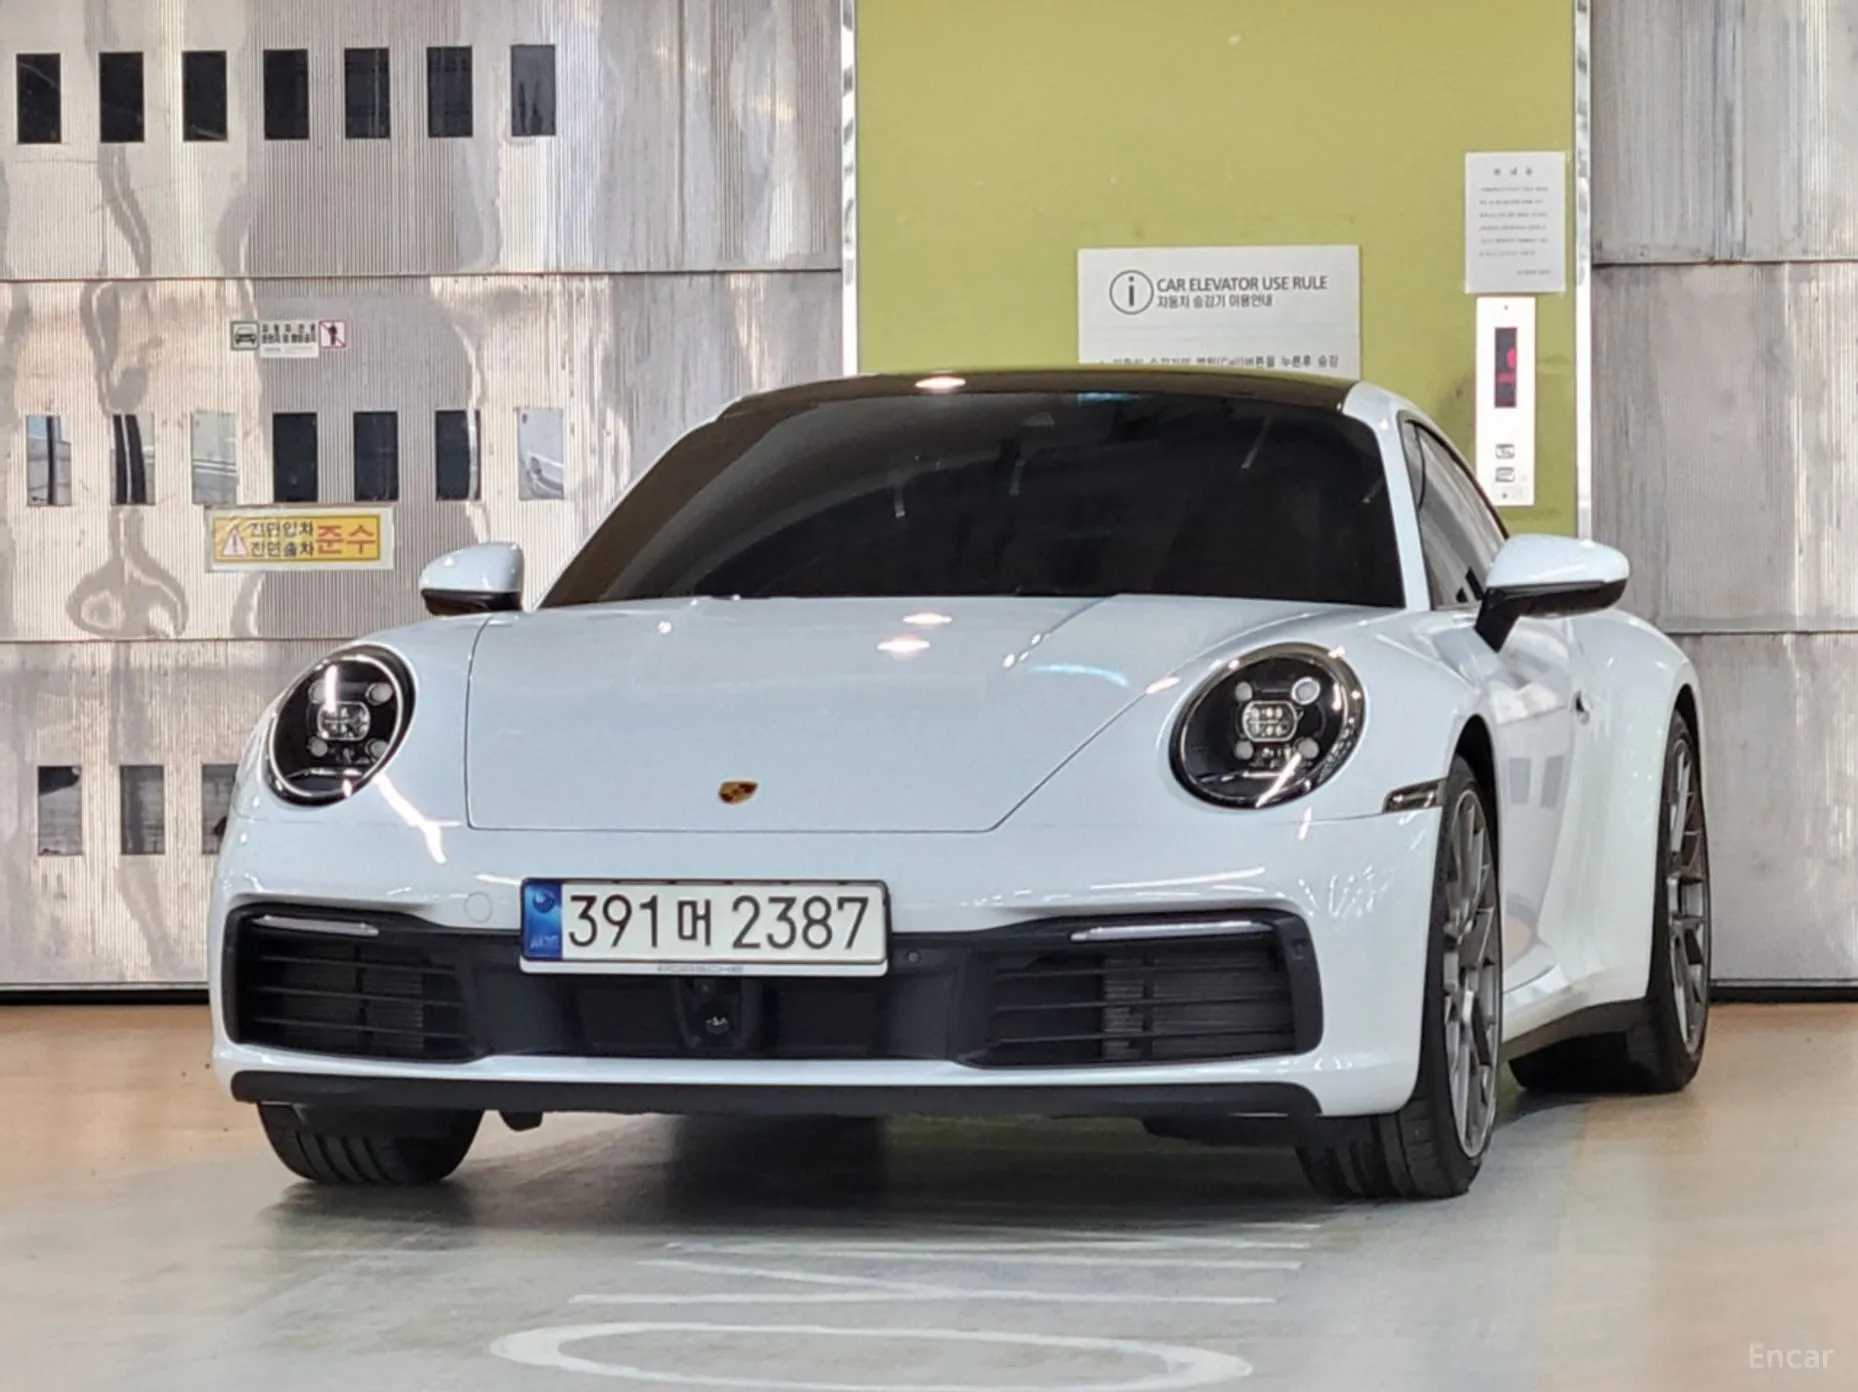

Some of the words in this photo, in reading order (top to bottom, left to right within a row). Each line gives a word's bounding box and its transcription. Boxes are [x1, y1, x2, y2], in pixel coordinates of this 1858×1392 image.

[1156, 278, 1186, 292] CAR
[1189, 276, 1259, 292] ELEVATOR
[1262, 276, 1288, 290] USE
[1292, 275, 1328, 290] RULE
[1193, 293, 1226, 309] 승강기
[316, 524, 375, 555] 준수
[731, 895, 869, 950] 2387
